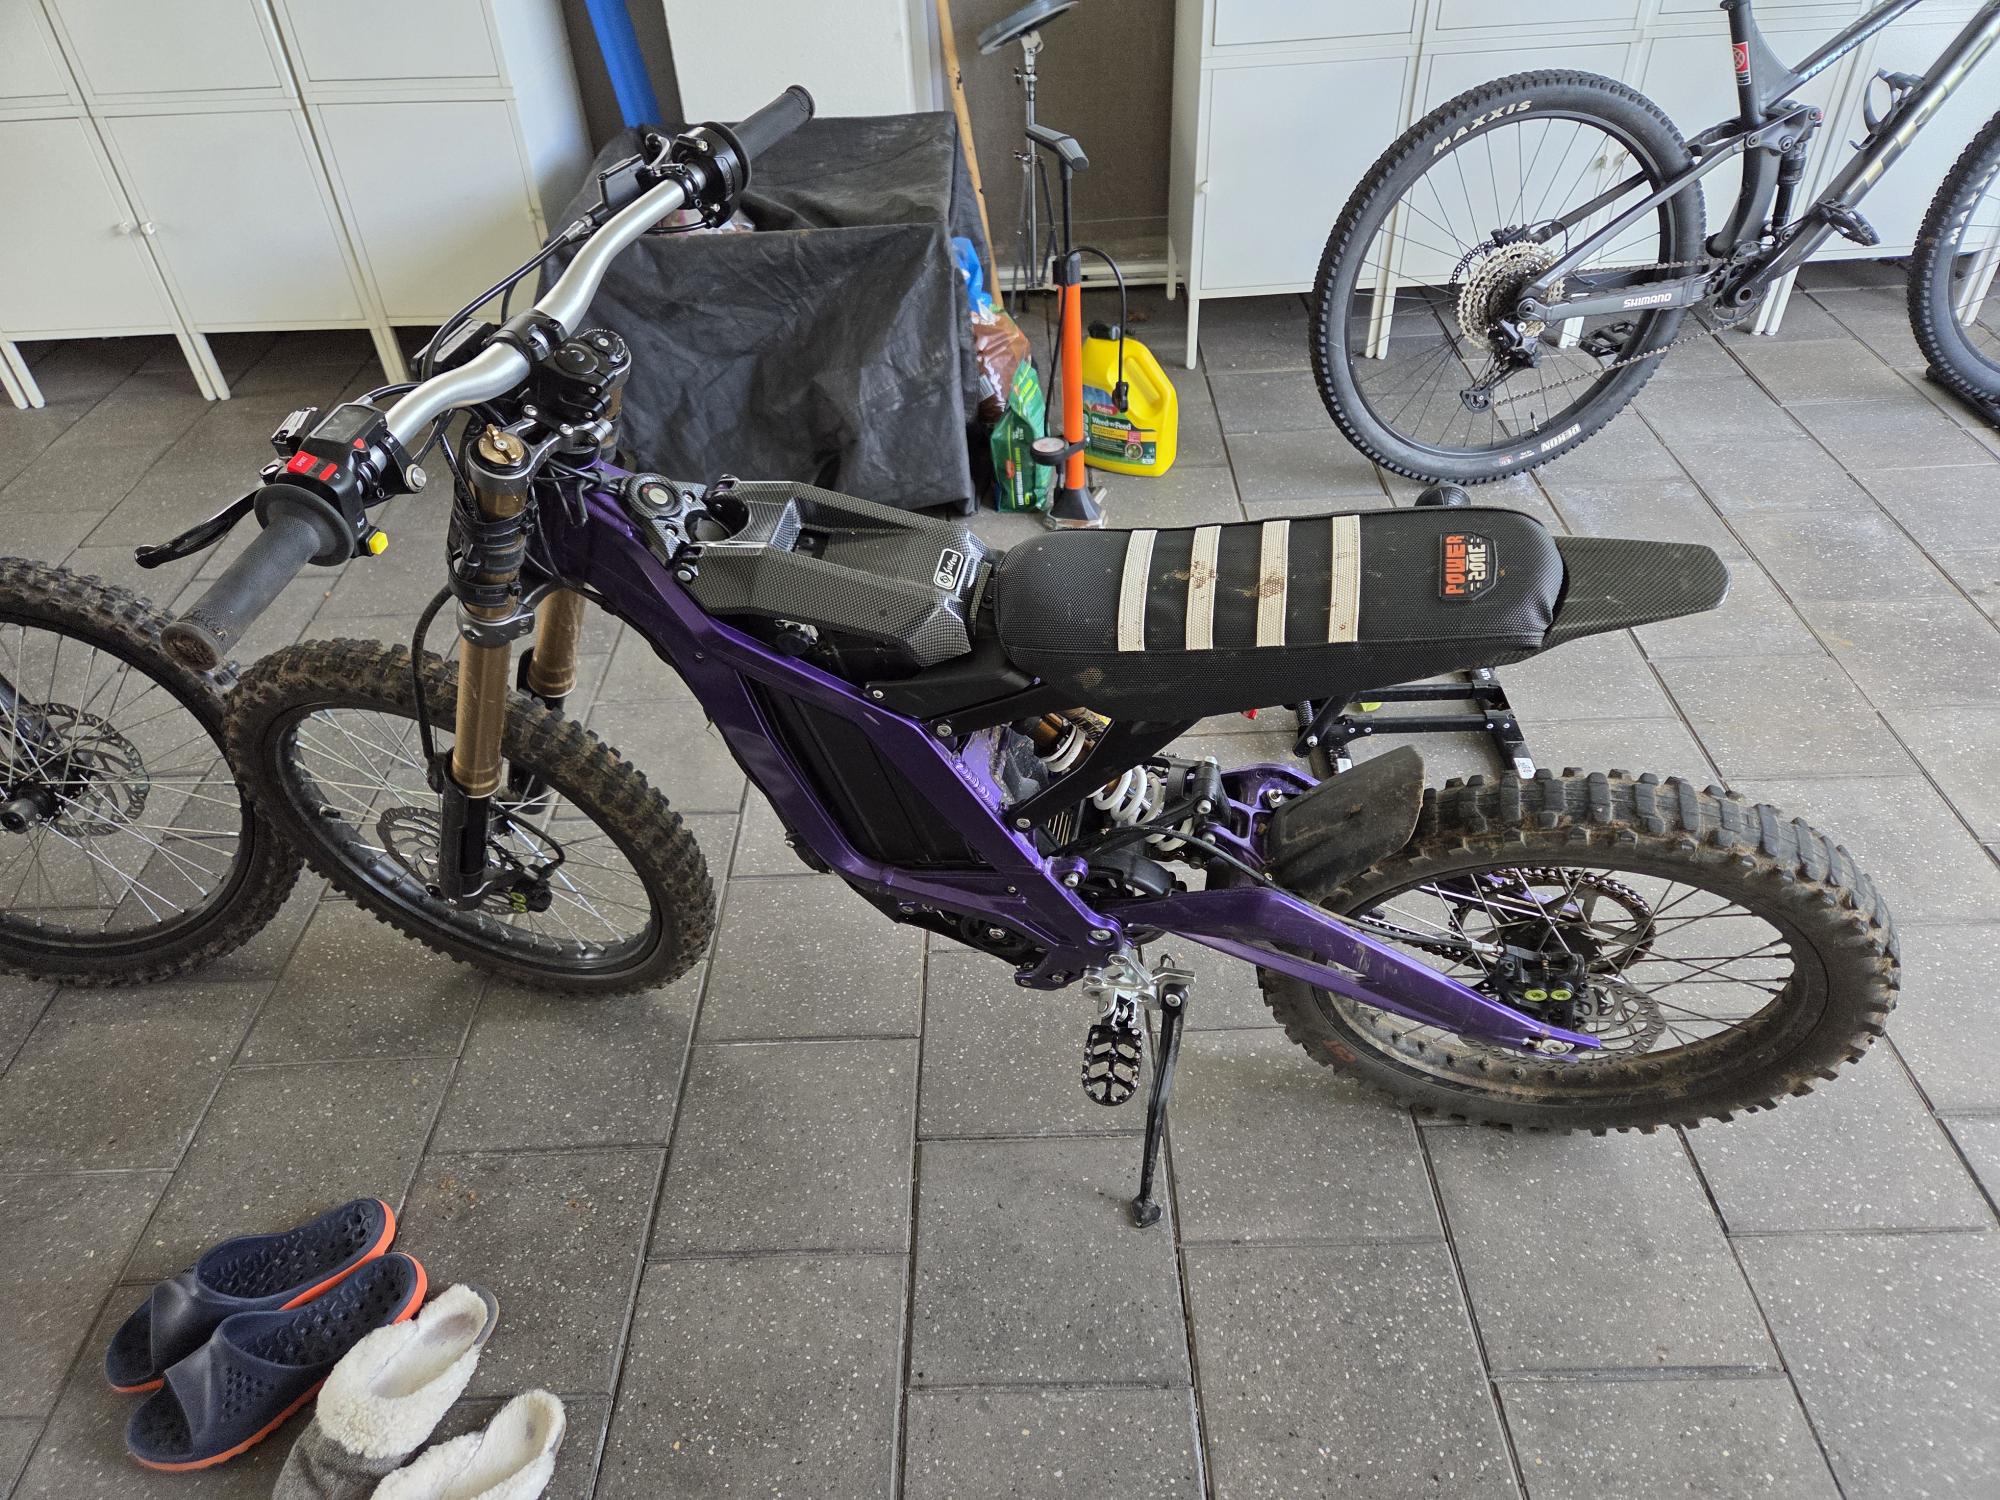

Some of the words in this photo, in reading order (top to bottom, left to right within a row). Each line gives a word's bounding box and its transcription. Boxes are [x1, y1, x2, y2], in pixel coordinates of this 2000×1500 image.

[1433, 100, 1532, 156] MAXXIS
[1949, 157, 2000, 245] MAXXI
[1623, 293, 1673, 308] SHIMANO
[1446, 535, 1466, 594] POWER
[1467, 544, 1486, 581] ZONE
